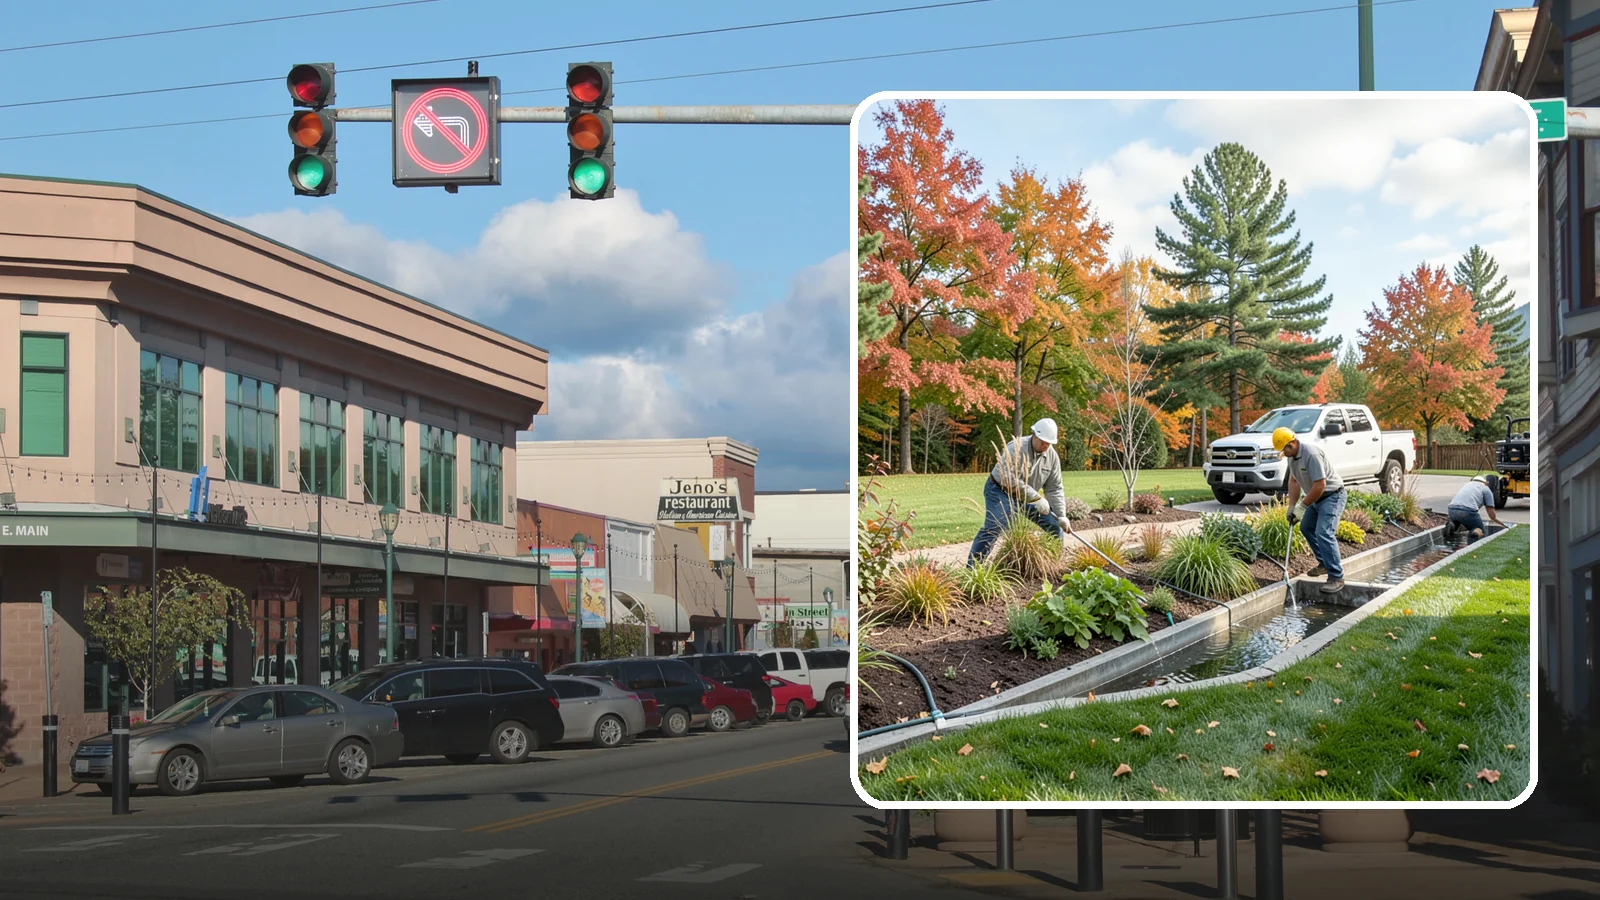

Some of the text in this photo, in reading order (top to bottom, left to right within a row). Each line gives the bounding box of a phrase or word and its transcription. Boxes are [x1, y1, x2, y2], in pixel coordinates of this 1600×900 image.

[670, 480, 727, 494] Jeno's
[665, 497, 731, 509] restaurant
[686, 509, 714, 519] American
[715, 509, 737, 519] Cuisine
[2, 525, 49, 536] E. MAIN
[797, 608, 828, 617] Street
